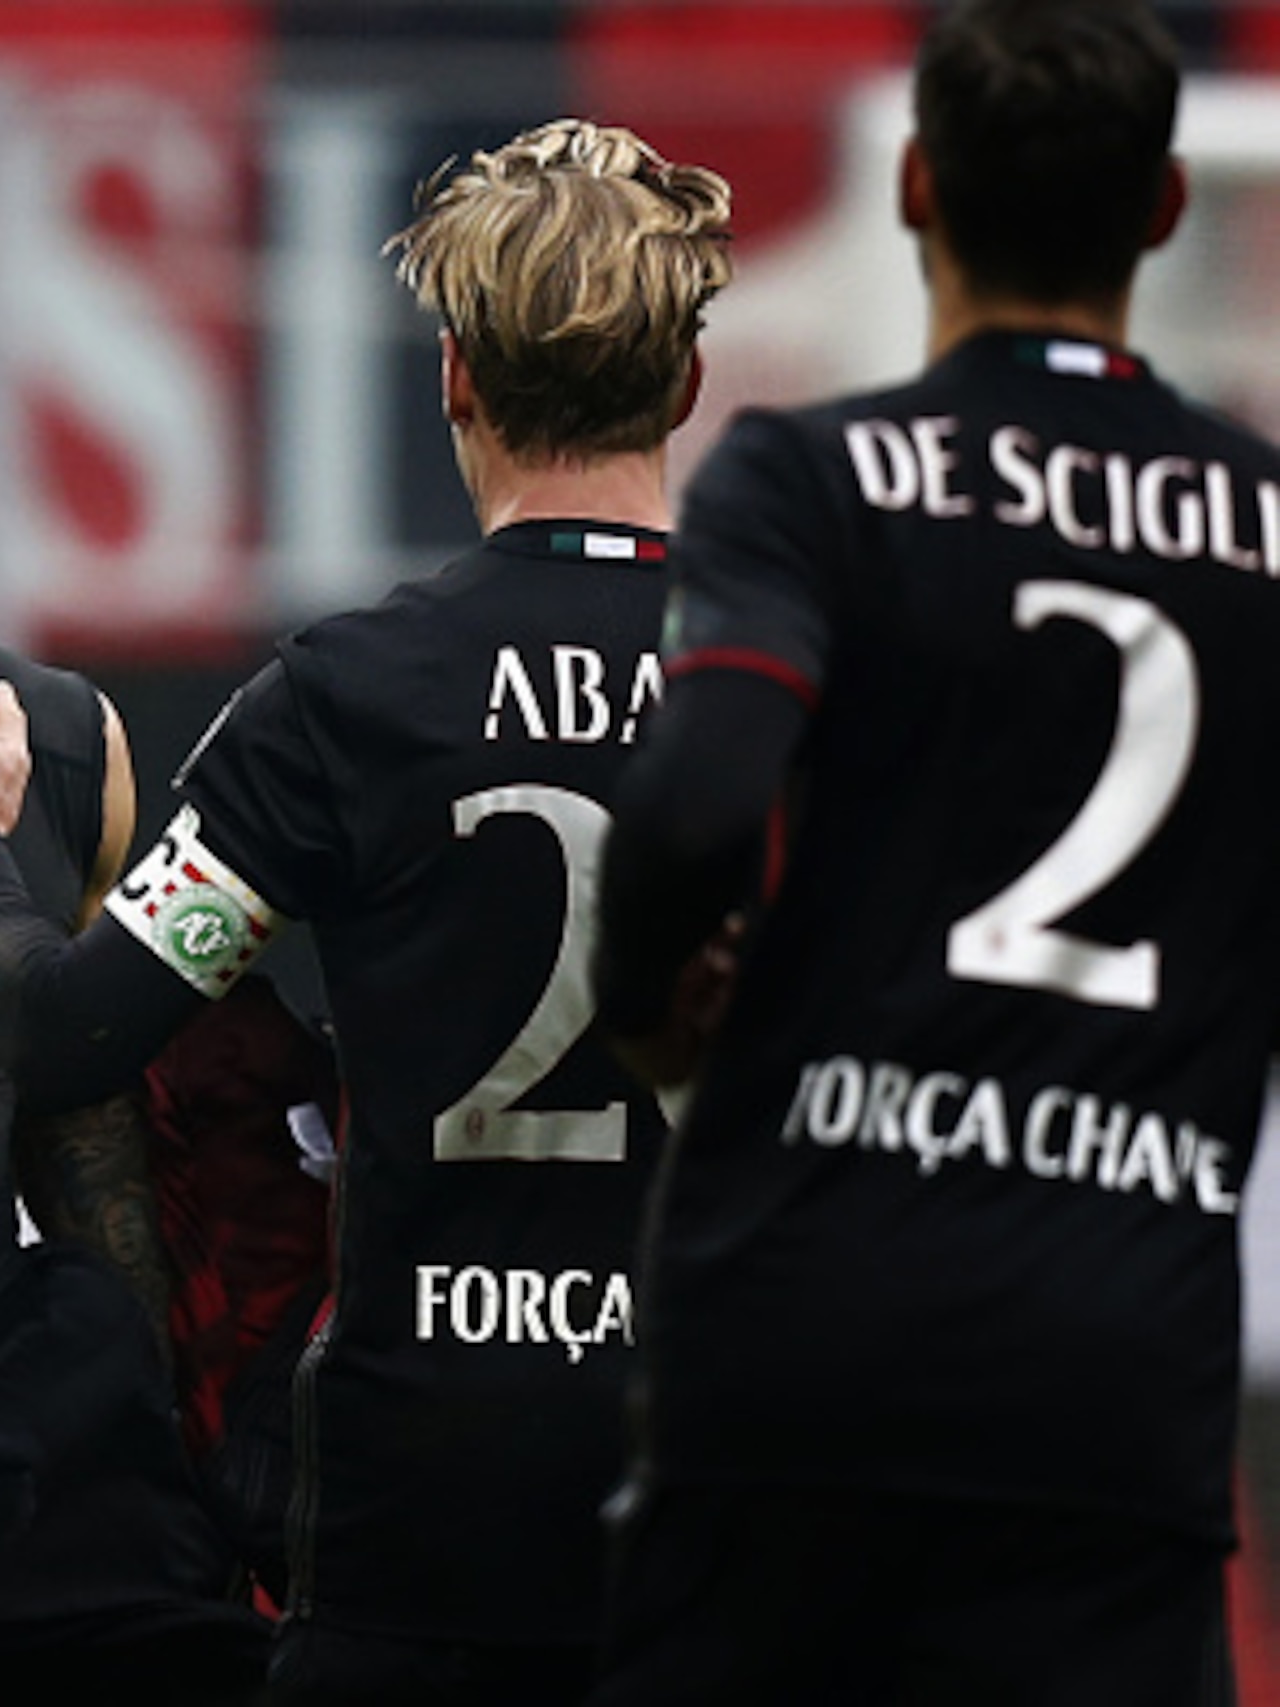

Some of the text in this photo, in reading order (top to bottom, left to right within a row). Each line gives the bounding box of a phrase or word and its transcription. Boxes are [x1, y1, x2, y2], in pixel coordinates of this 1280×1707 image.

[842, 416, 1280, 579] DE SCIGLI
[945, 579, 1199, 1010] 2
[415, 1264, 634, 1364] FORÇA
